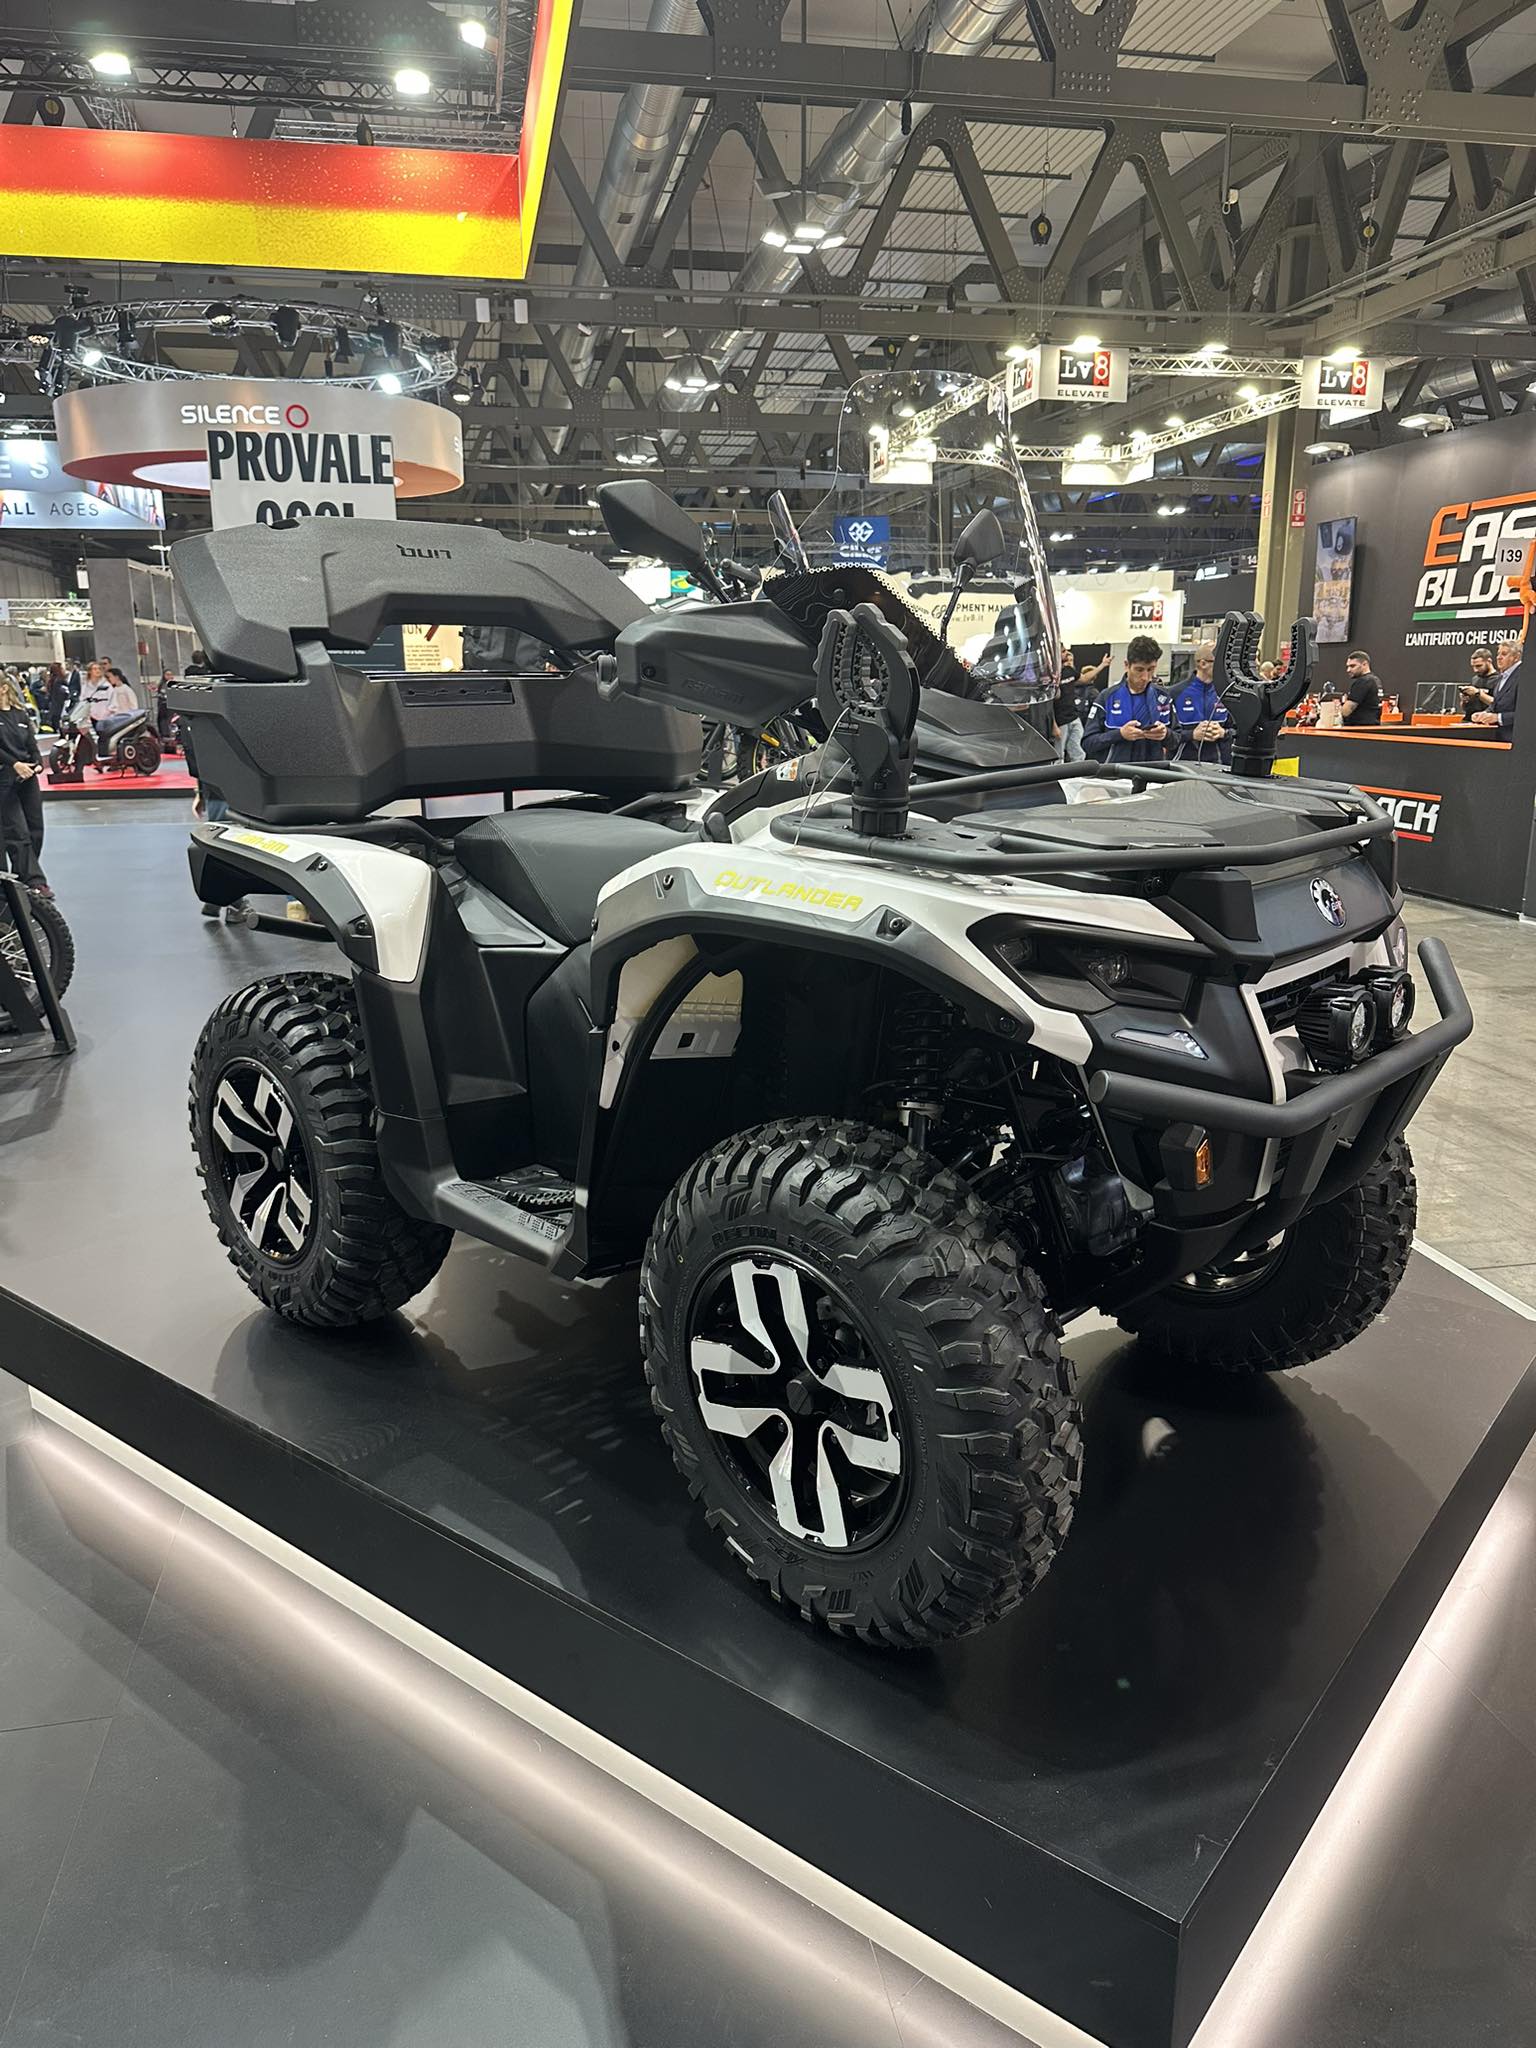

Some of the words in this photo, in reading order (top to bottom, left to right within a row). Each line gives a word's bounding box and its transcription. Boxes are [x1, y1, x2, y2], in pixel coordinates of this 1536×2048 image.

[1061, 355, 1109, 379] Lv8
[1320, 365, 1367, 389] Lv8
[1057, 389, 1109, 398] ELEVATE
[1317, 398, 1366, 407] ELEVATE
[180, 404, 281, 426] SILENCE
[207, 430, 394, 484] PROVALE
[0, 502, 35, 516] ALL
[50, 502, 99, 517] AGES
[1500, 549, 1523, 563] 139
[1131, 602, 1163, 618] Lv8
[1405, 631, 1464, 647] L'ANTIFURTO
[1466, 630, 1488, 646] CHE
[714, 869, 864, 912] OUTLANDER
